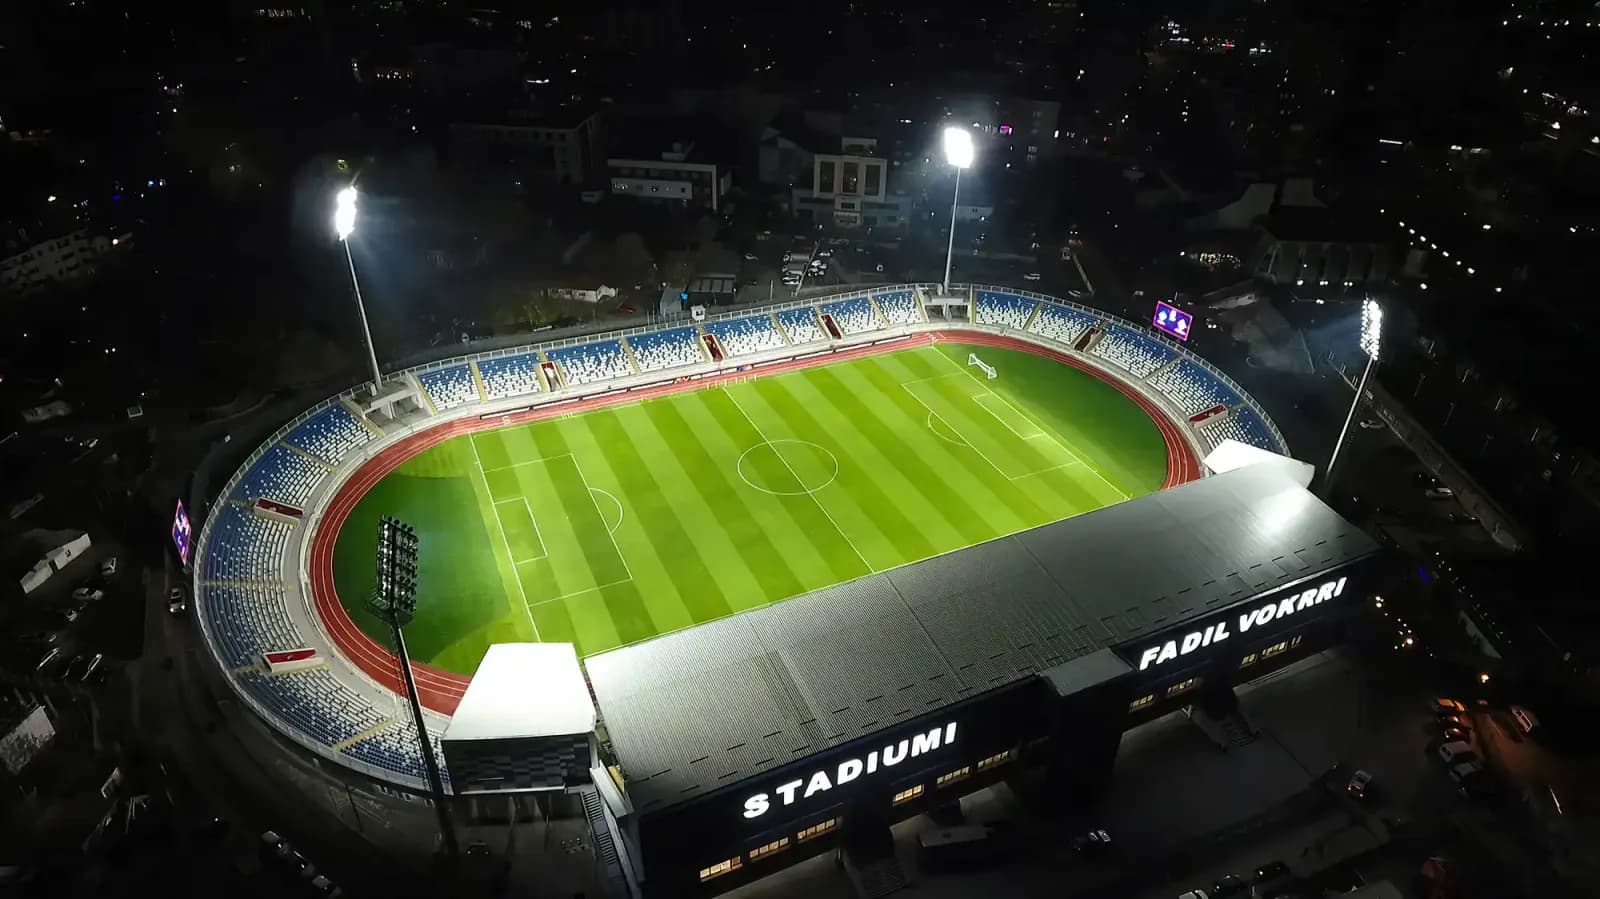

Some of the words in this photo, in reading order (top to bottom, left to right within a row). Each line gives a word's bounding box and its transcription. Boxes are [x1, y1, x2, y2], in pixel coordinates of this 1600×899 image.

[743, 722, 957, 819] STADIUMI
[1139, 621, 1230, 671] FADIL
[1239, 576, 1348, 633] VOKRRI
